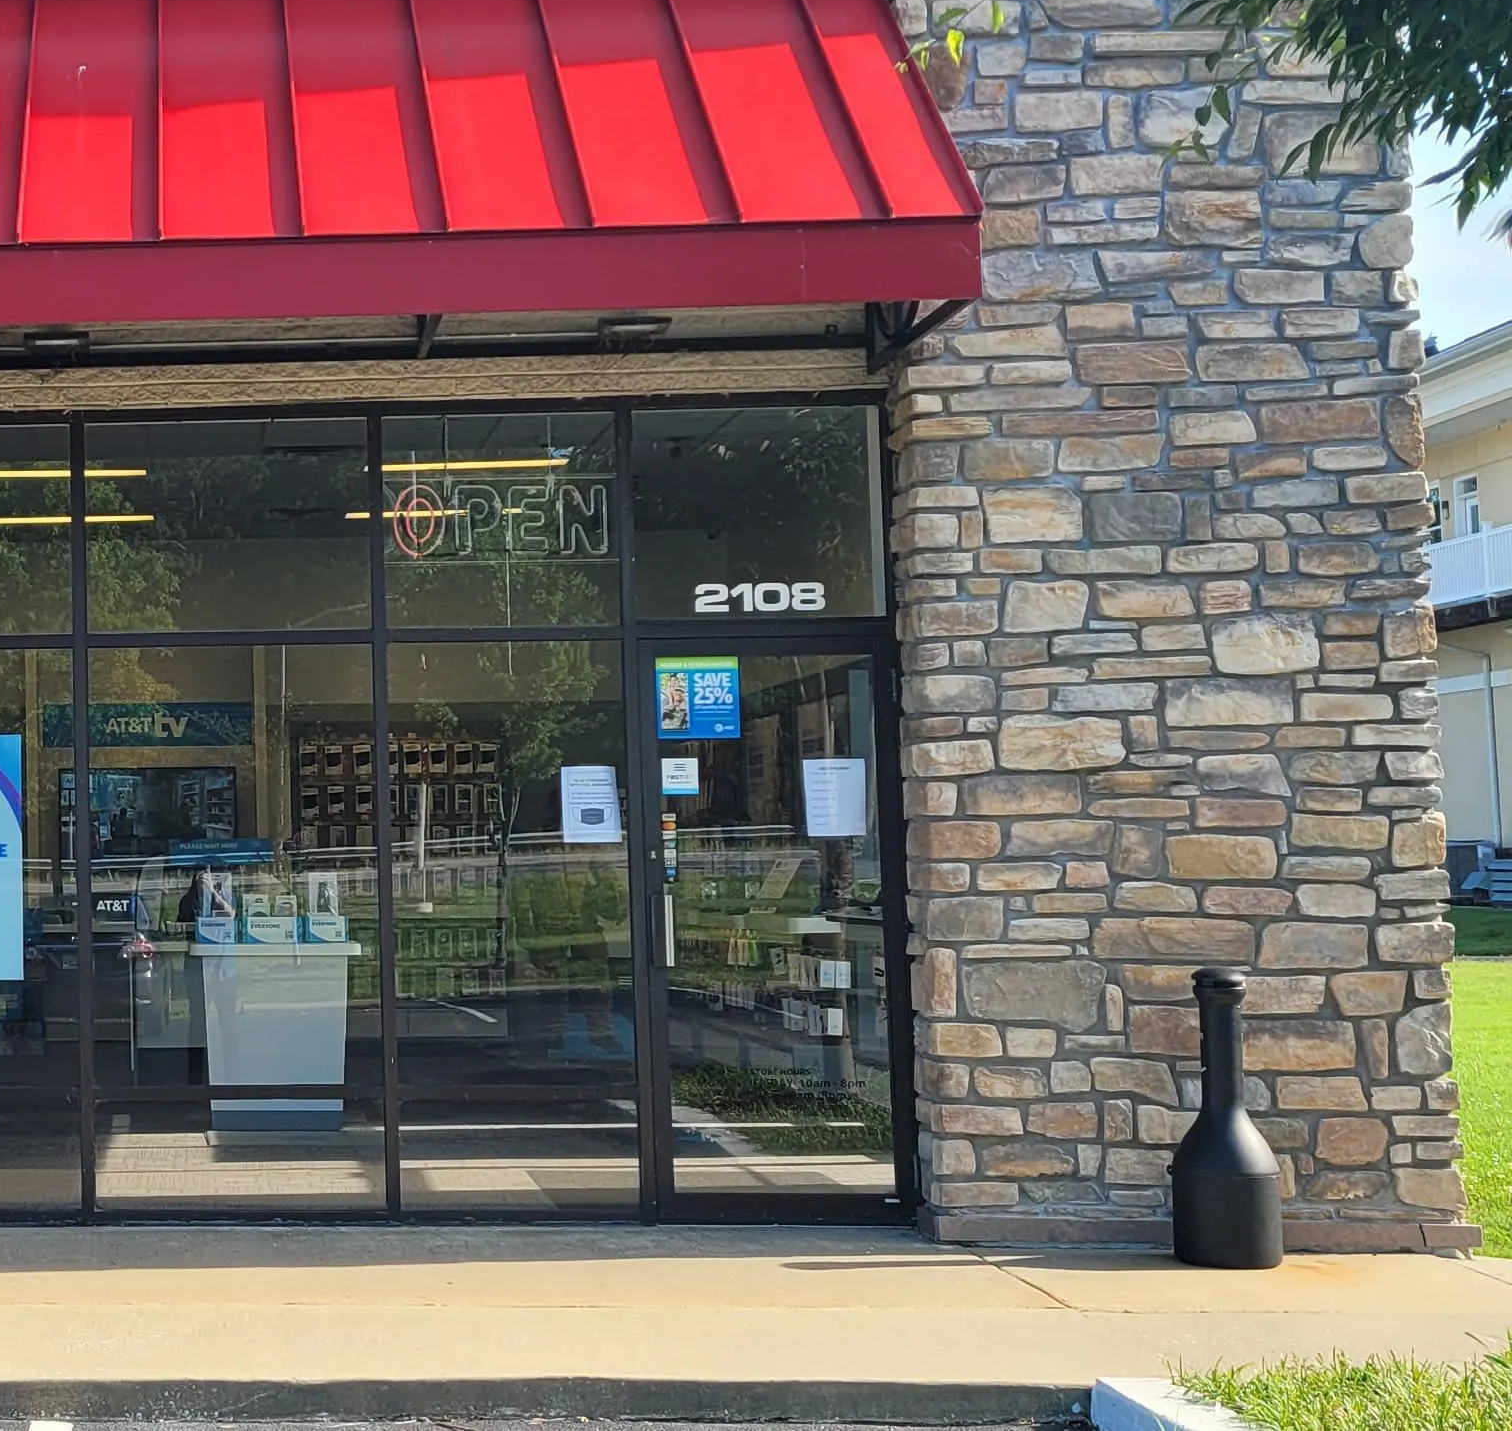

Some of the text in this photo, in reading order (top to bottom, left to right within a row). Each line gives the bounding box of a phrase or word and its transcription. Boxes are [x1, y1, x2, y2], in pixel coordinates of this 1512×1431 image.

[393, 484, 608, 558] OPEN
[694, 582, 826, 613] 2108
[693, 672, 732, 687] SAVE
[693, 688, 734, 704] 25%
[106, 712, 189, 738] AT&T tv
[96, 899, 130, 912] AT&T
